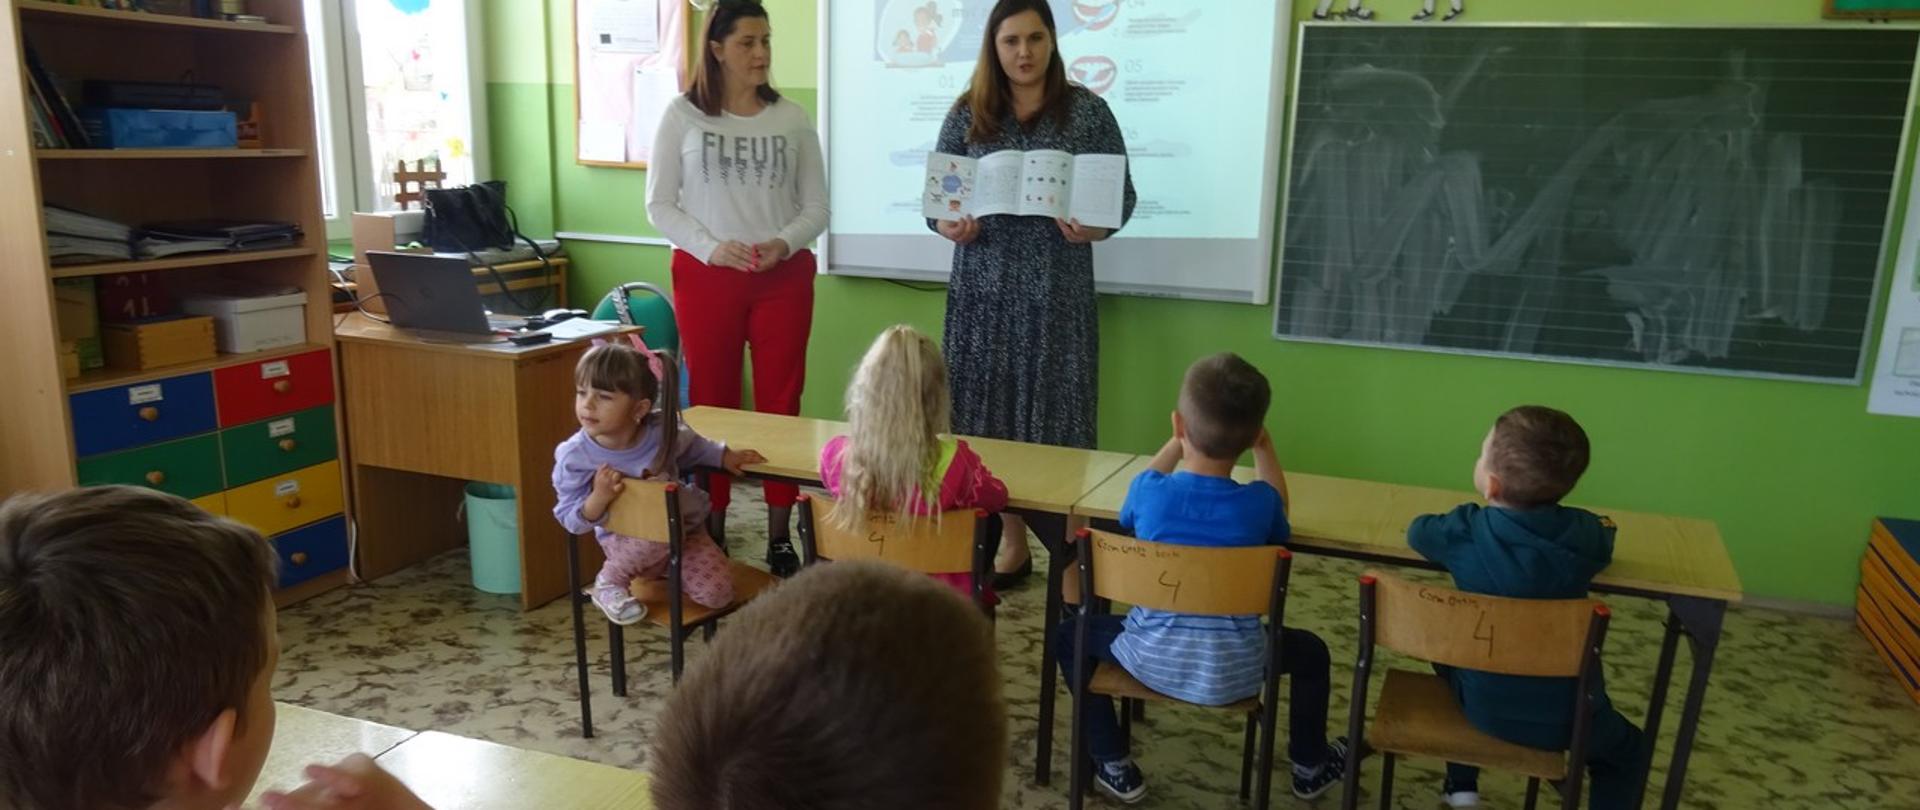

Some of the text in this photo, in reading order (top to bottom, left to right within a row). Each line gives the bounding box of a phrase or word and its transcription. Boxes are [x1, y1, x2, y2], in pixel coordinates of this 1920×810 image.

[1124, 59, 1143, 73] 05
[702, 131, 788, 183] FLEUR
[1158, 570, 1181, 604] 4
[1473, 610, 1494, 659] 4
